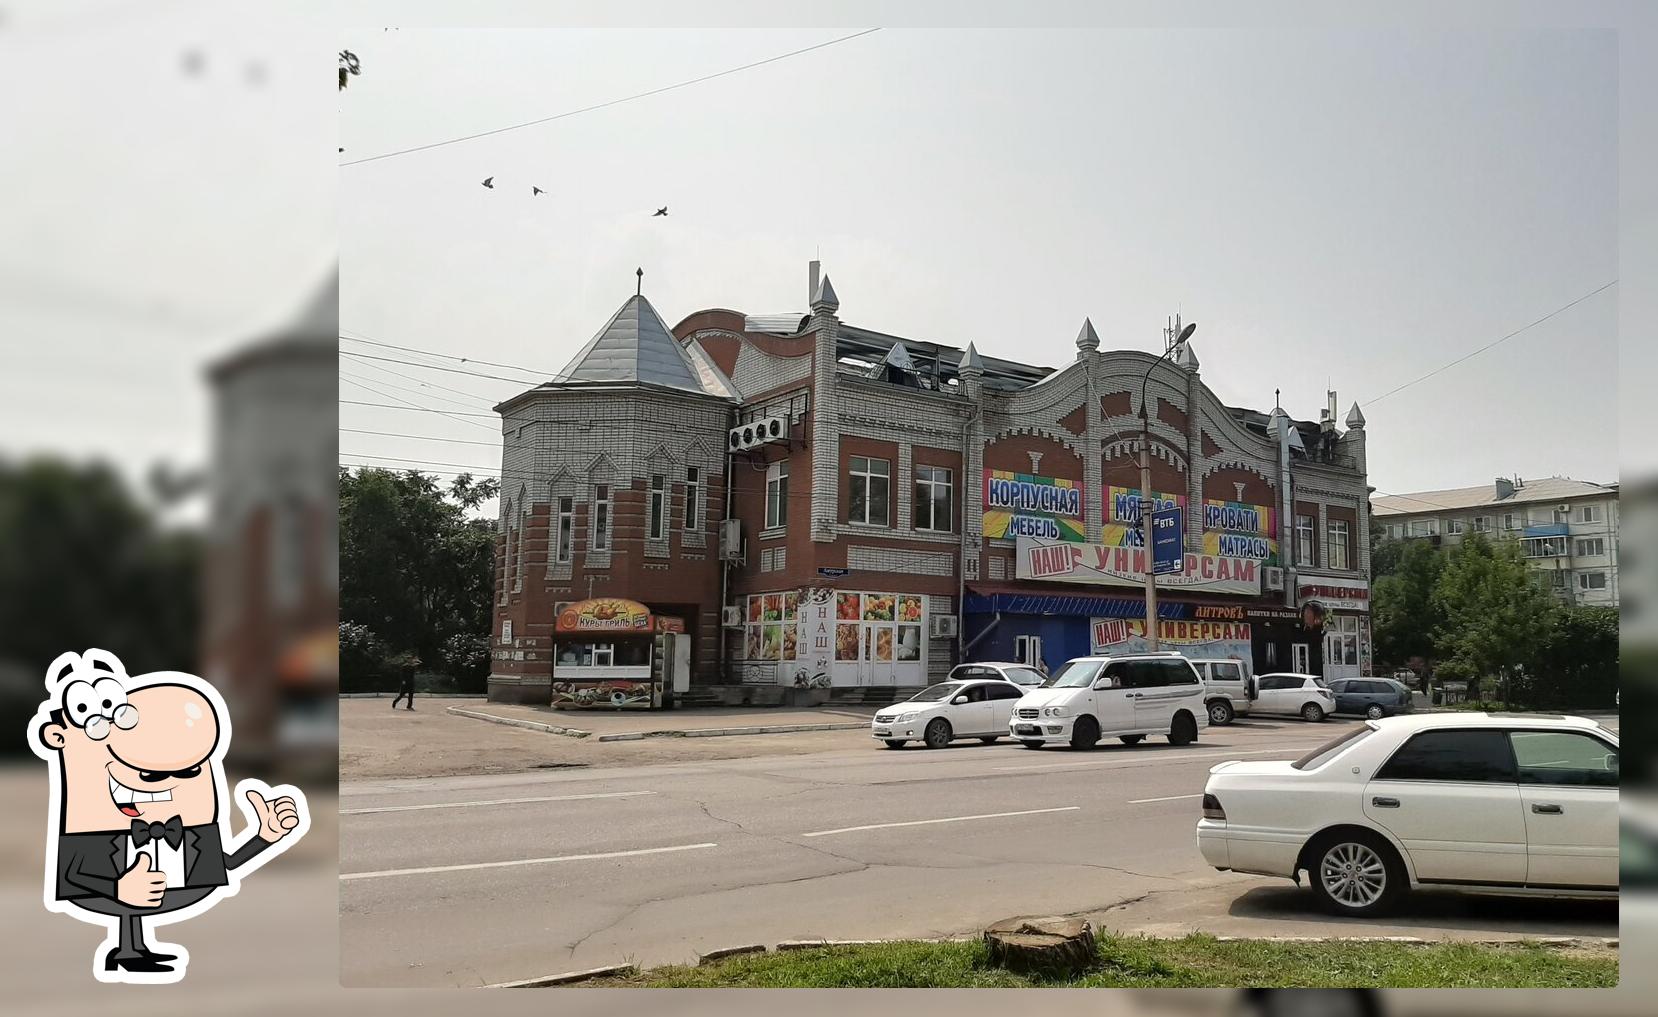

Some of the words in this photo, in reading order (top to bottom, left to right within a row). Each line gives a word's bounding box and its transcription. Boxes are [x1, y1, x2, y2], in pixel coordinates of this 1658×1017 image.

[989, 478, 1080, 515] КОРПУСНАЯ
[1009, 515, 1059, 540] МЕБЕЛЬ
[1160, 517, 1175, 529] ВТБ
[1204, 504, 1258, 533] КРОВАТИ
[1218, 534, 1269, 559] МАТРАСЫ
[1031, 545, 1071, 575] НАШ!
[1094, 546, 1255, 582] УНИРСАМ
[580, 617, 603, 628] КУРЫ
[605, 619, 630, 628] ГРИЛЬ
[1194, 605, 1244, 619] ЛИТРОВЪ
[1095, 620, 1126, 646] НАШ!
